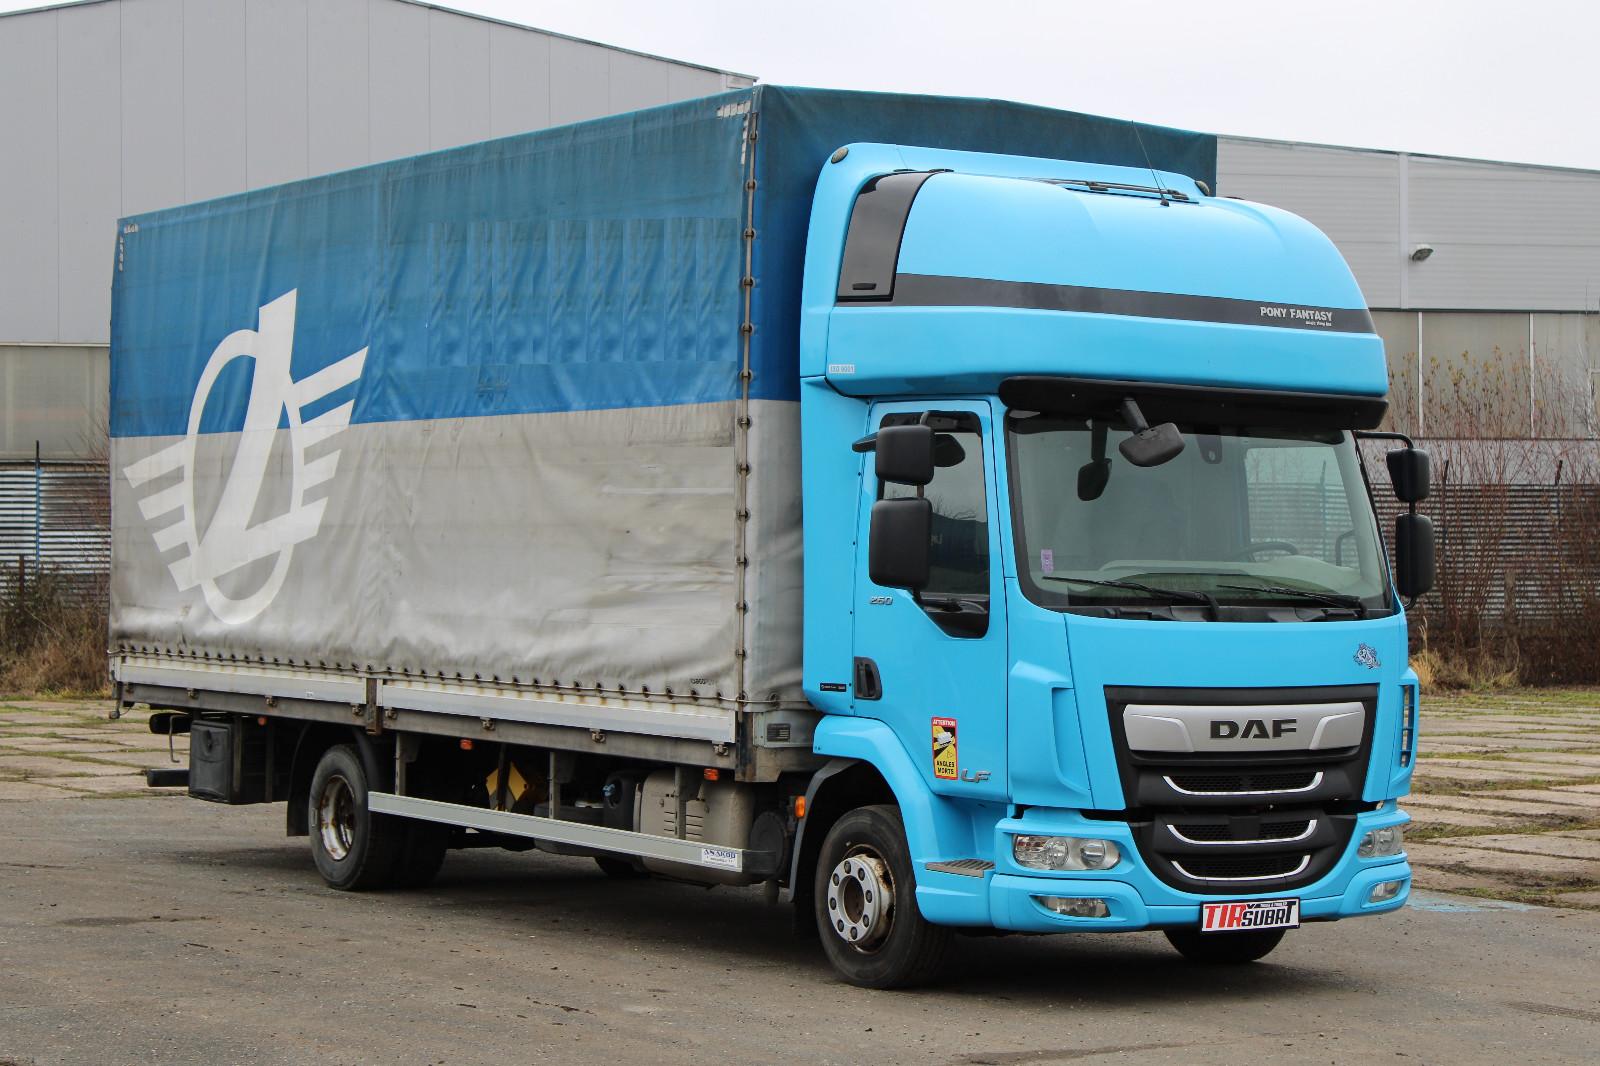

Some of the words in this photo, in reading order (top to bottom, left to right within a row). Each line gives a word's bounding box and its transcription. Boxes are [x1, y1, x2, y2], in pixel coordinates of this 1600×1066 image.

[1260, 306, 1287, 318] PONY
[1289, 308, 1332, 322] FANTASY
[870, 596, 894, 606] 260
[932, 719, 956, 727] ATTENTION
[1210, 718, 1297, 739] DAF
[936, 760, 955, 768] ANGLES
[937, 767, 954, 775] MORTS
[961, 768, 992, 783] LF
[1205, 904, 1247, 929] TIR
